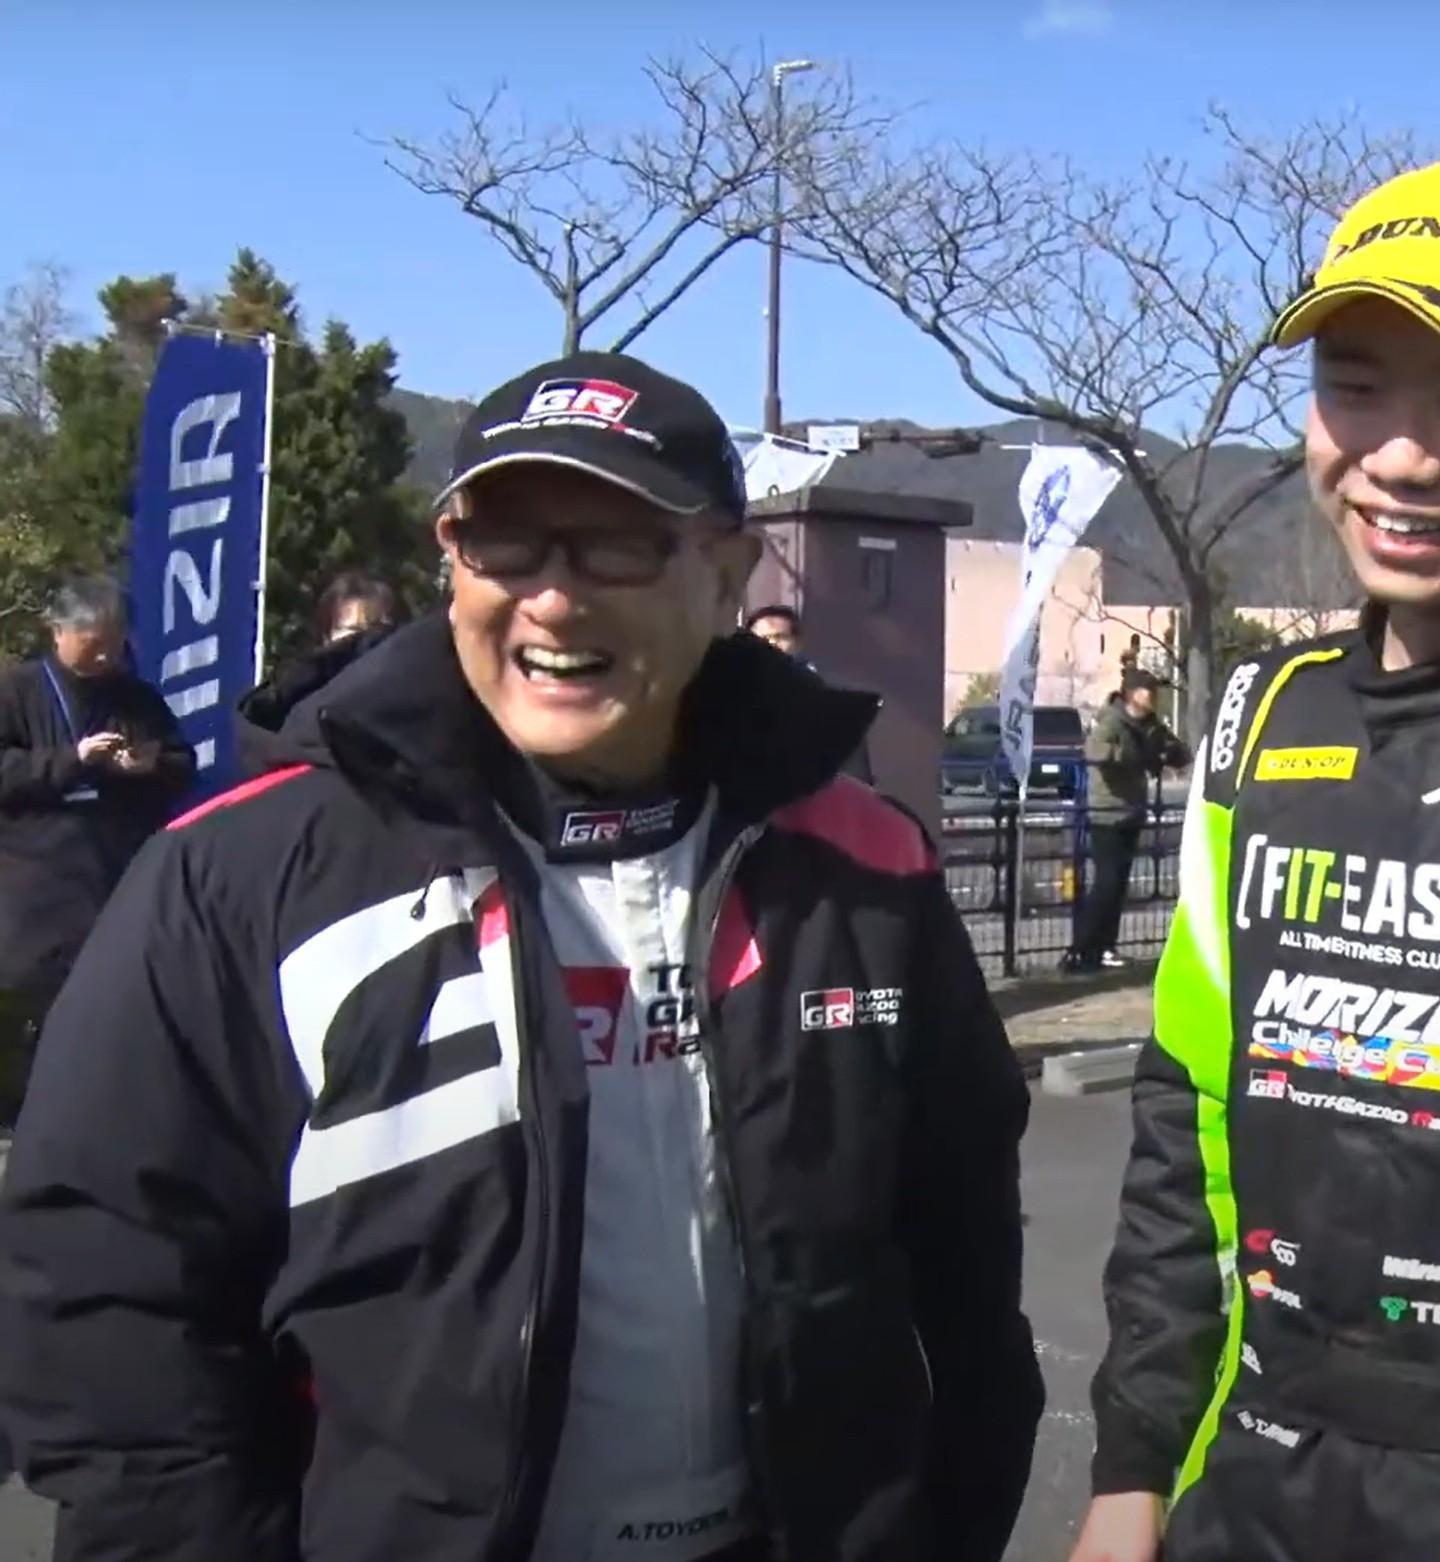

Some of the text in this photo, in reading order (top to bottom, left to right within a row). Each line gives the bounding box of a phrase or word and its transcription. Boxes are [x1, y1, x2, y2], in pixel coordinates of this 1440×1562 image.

[527, 385, 629, 418] GR
[564, 817, 622, 844] GR
[802, 997, 853, 1029] GR
